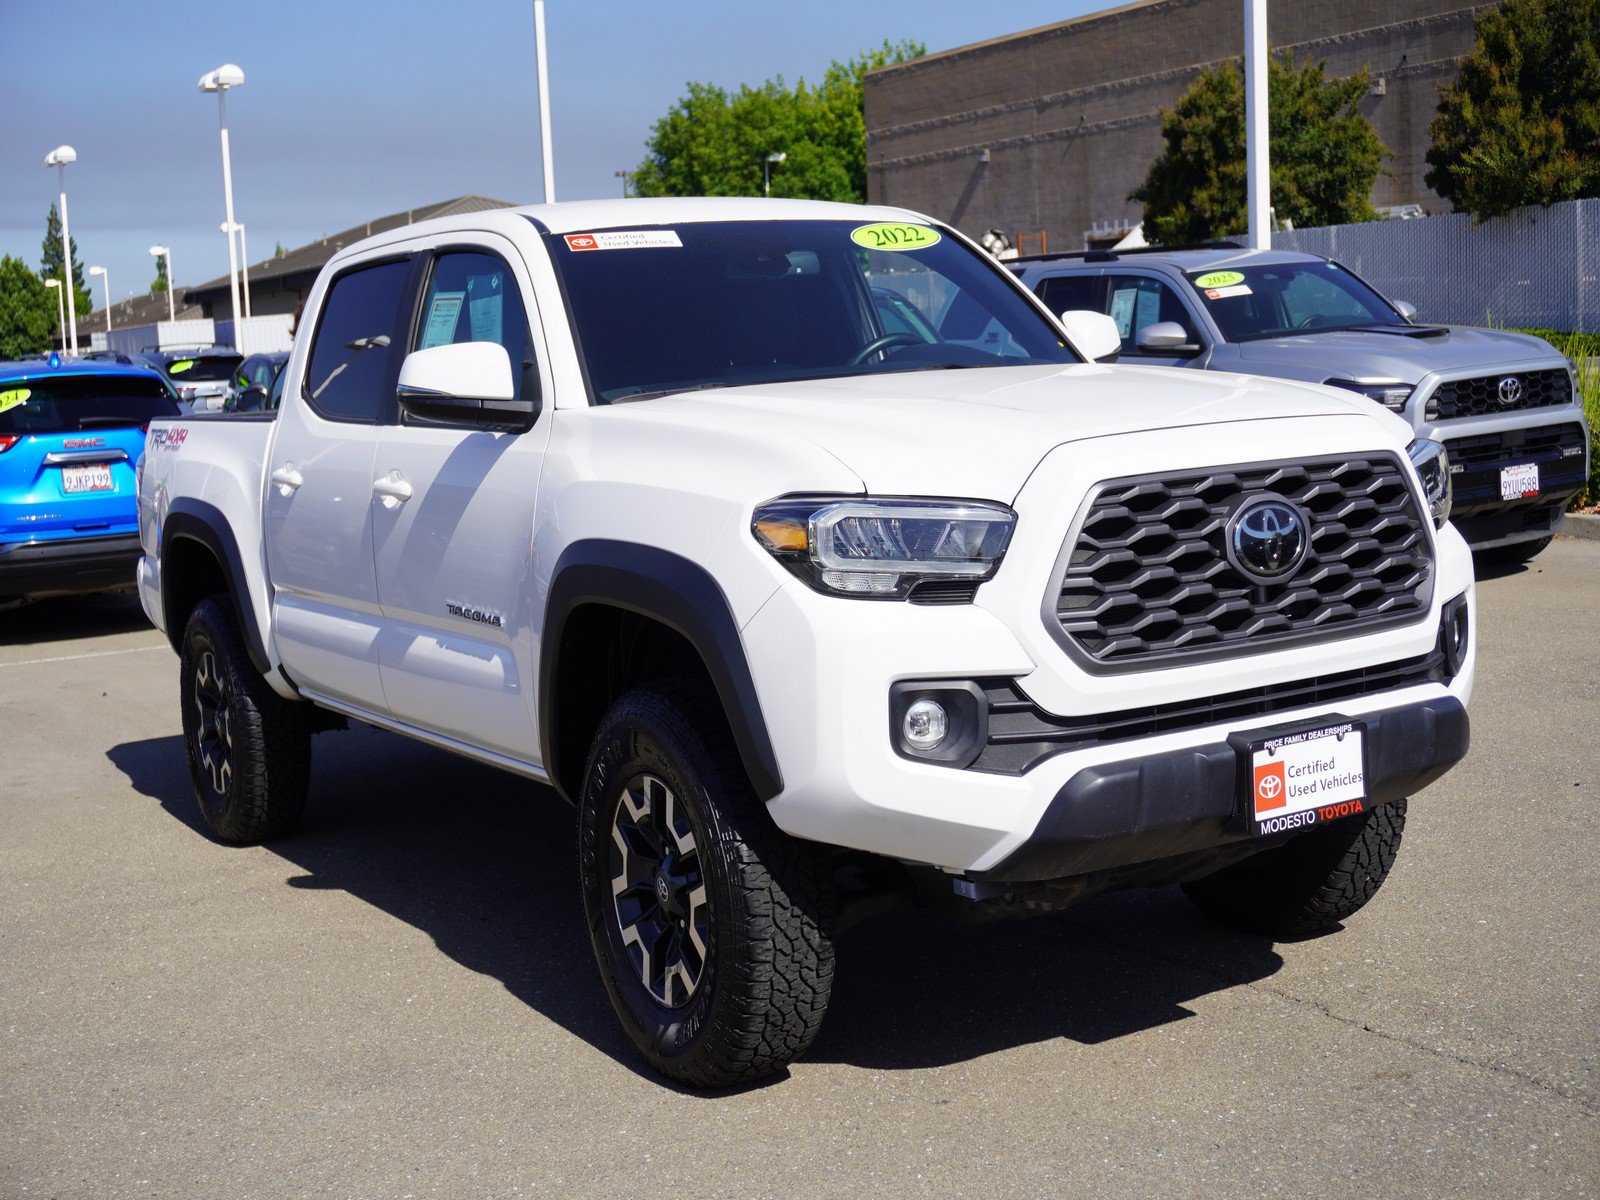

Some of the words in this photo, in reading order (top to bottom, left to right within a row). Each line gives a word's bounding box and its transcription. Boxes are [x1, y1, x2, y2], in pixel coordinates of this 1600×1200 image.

[603, 239, 630, 247] Used
[867, 226, 926, 247] 2022
[1205, 274, 1235, 286] 2025
[63, 437, 106, 449] GMC
[66, 474, 109, 489] 9JKP199
[446, 603, 502, 627] TACOMA
[1264, 740, 1283, 750] PRICE
[1284, 733, 1307, 745] FAMILY
[1308, 724, 1352, 740] DEALERSHIPS
[1287, 757, 1335, 779] Certified
[1288, 781, 1317, 798] Used
[1320, 772, 1363, 791] Vehicles
[1261, 811, 1315, 835] MODESTO
[1318, 800, 1363, 821] TOYOTA
